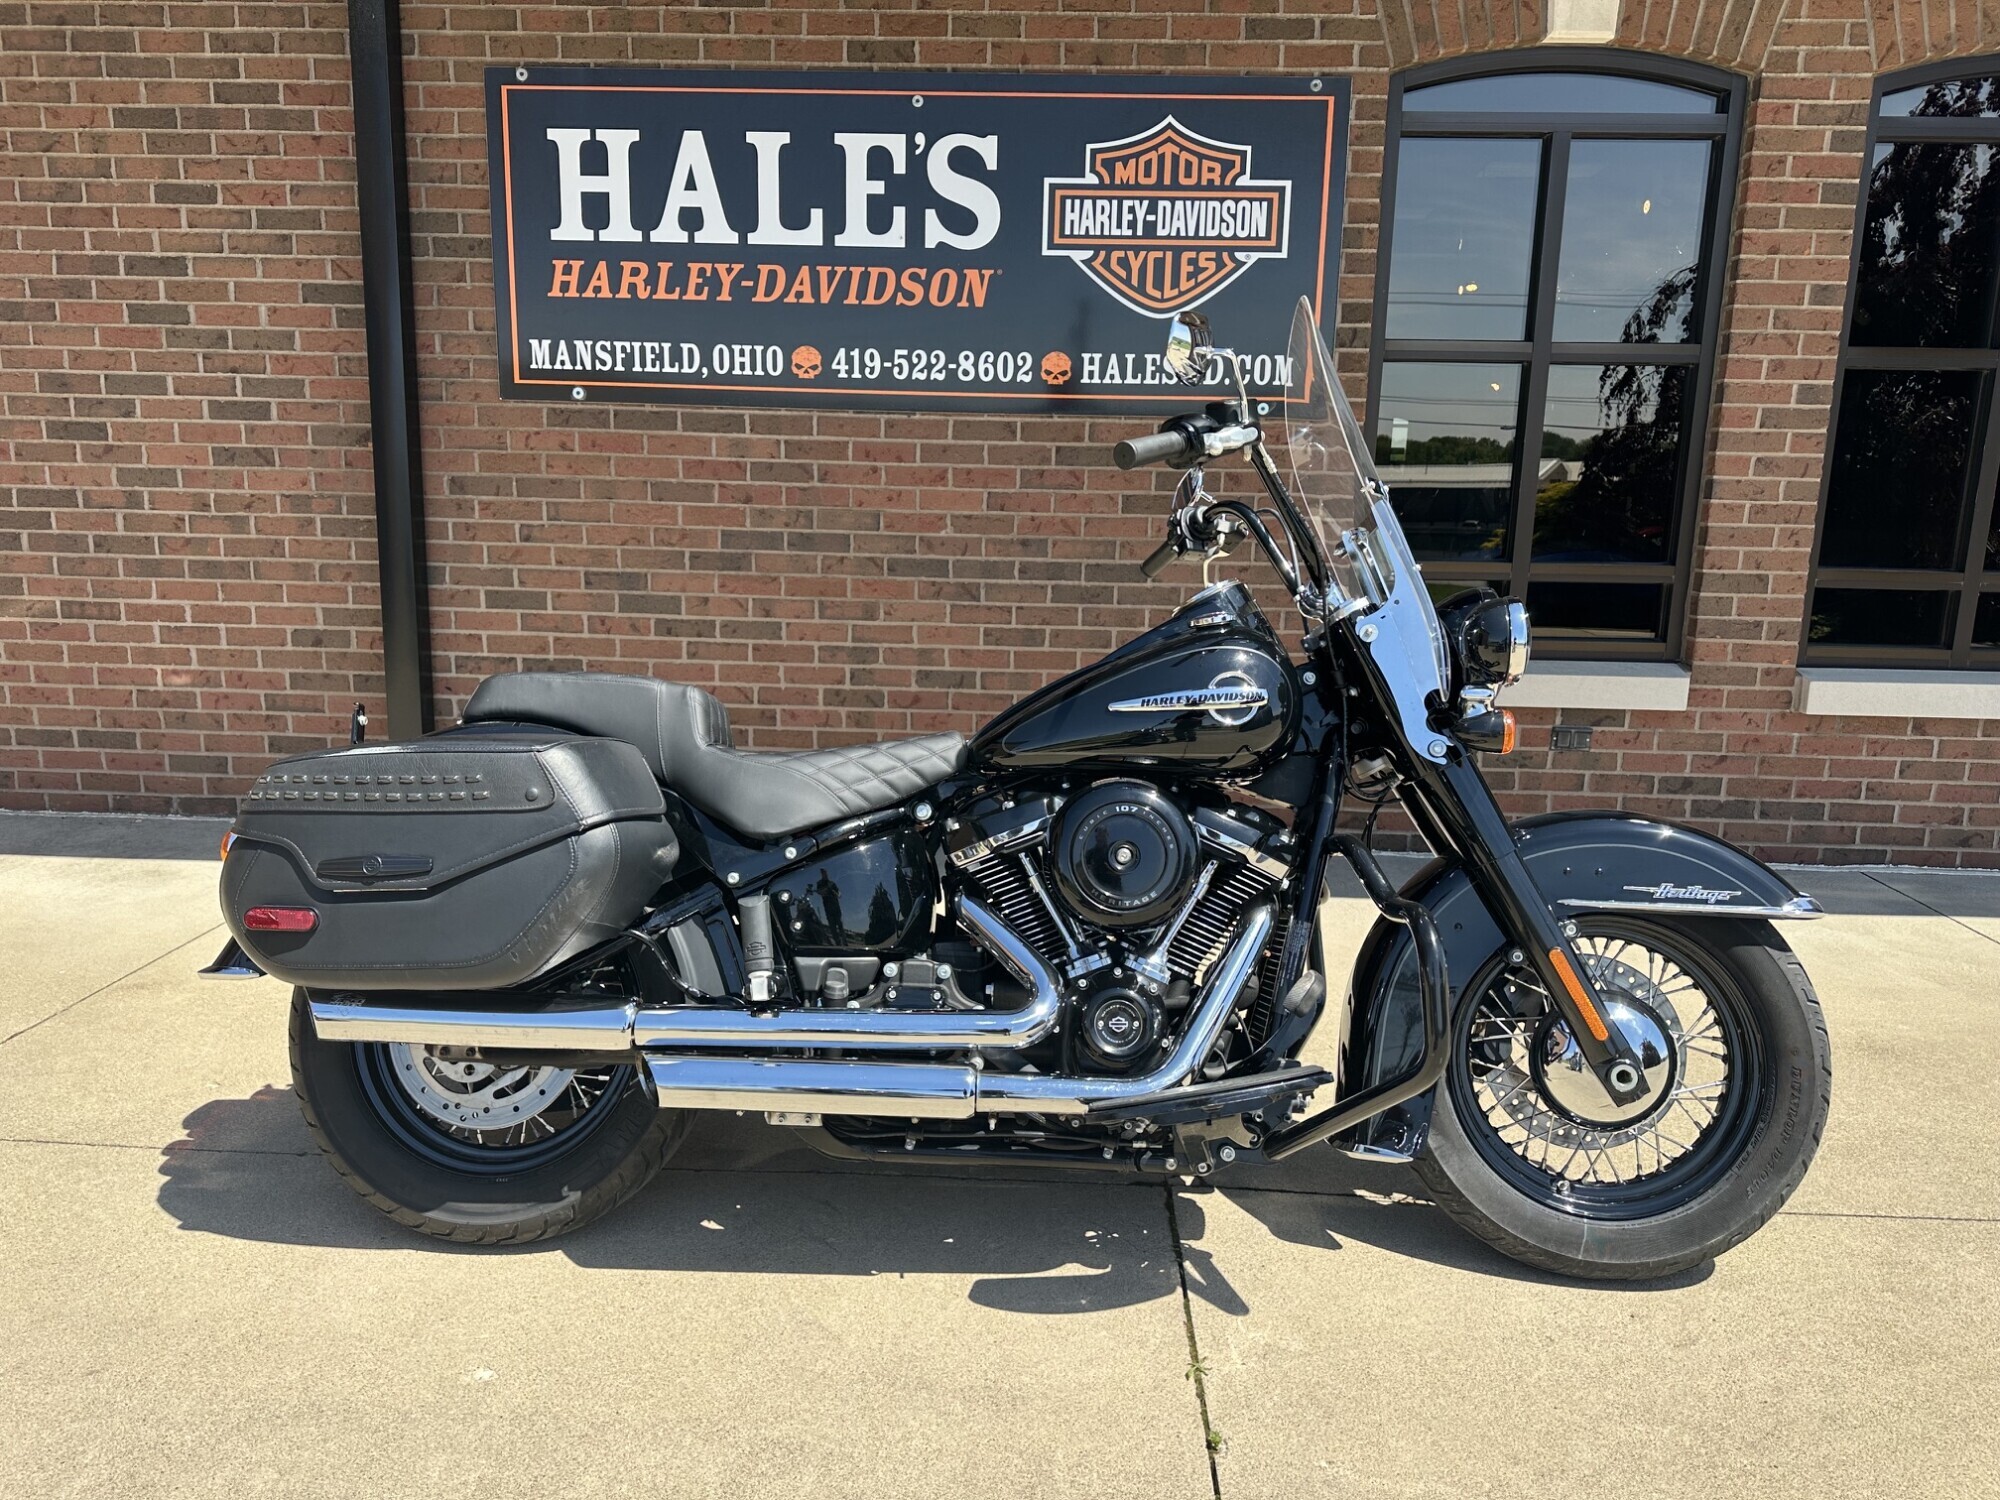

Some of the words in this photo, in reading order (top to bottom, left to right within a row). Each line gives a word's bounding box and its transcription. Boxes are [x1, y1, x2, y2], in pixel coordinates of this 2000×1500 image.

[1114, 141, 1222, 187] MOTOR
[546, 127, 1002, 251] HALE'S
[1064, 198, 1269, 238] HARLEY-DAVIDSON
[547, 258, 993, 308] HARLEY-DAVIDSON
[1110, 250, 1218, 300] CYCLES
[830, 347, 1034, 384] 419-522-8602
[1080, 351, 1295, 387] HALESD.COM
[1140, 691, 1264, 708] HARLEY-DAVIDSON
[1115, 804, 1140, 813] 107
[1091, 890, 1159, 908] HERITAGE
[1652, 882, 1731, 905] Heritage
